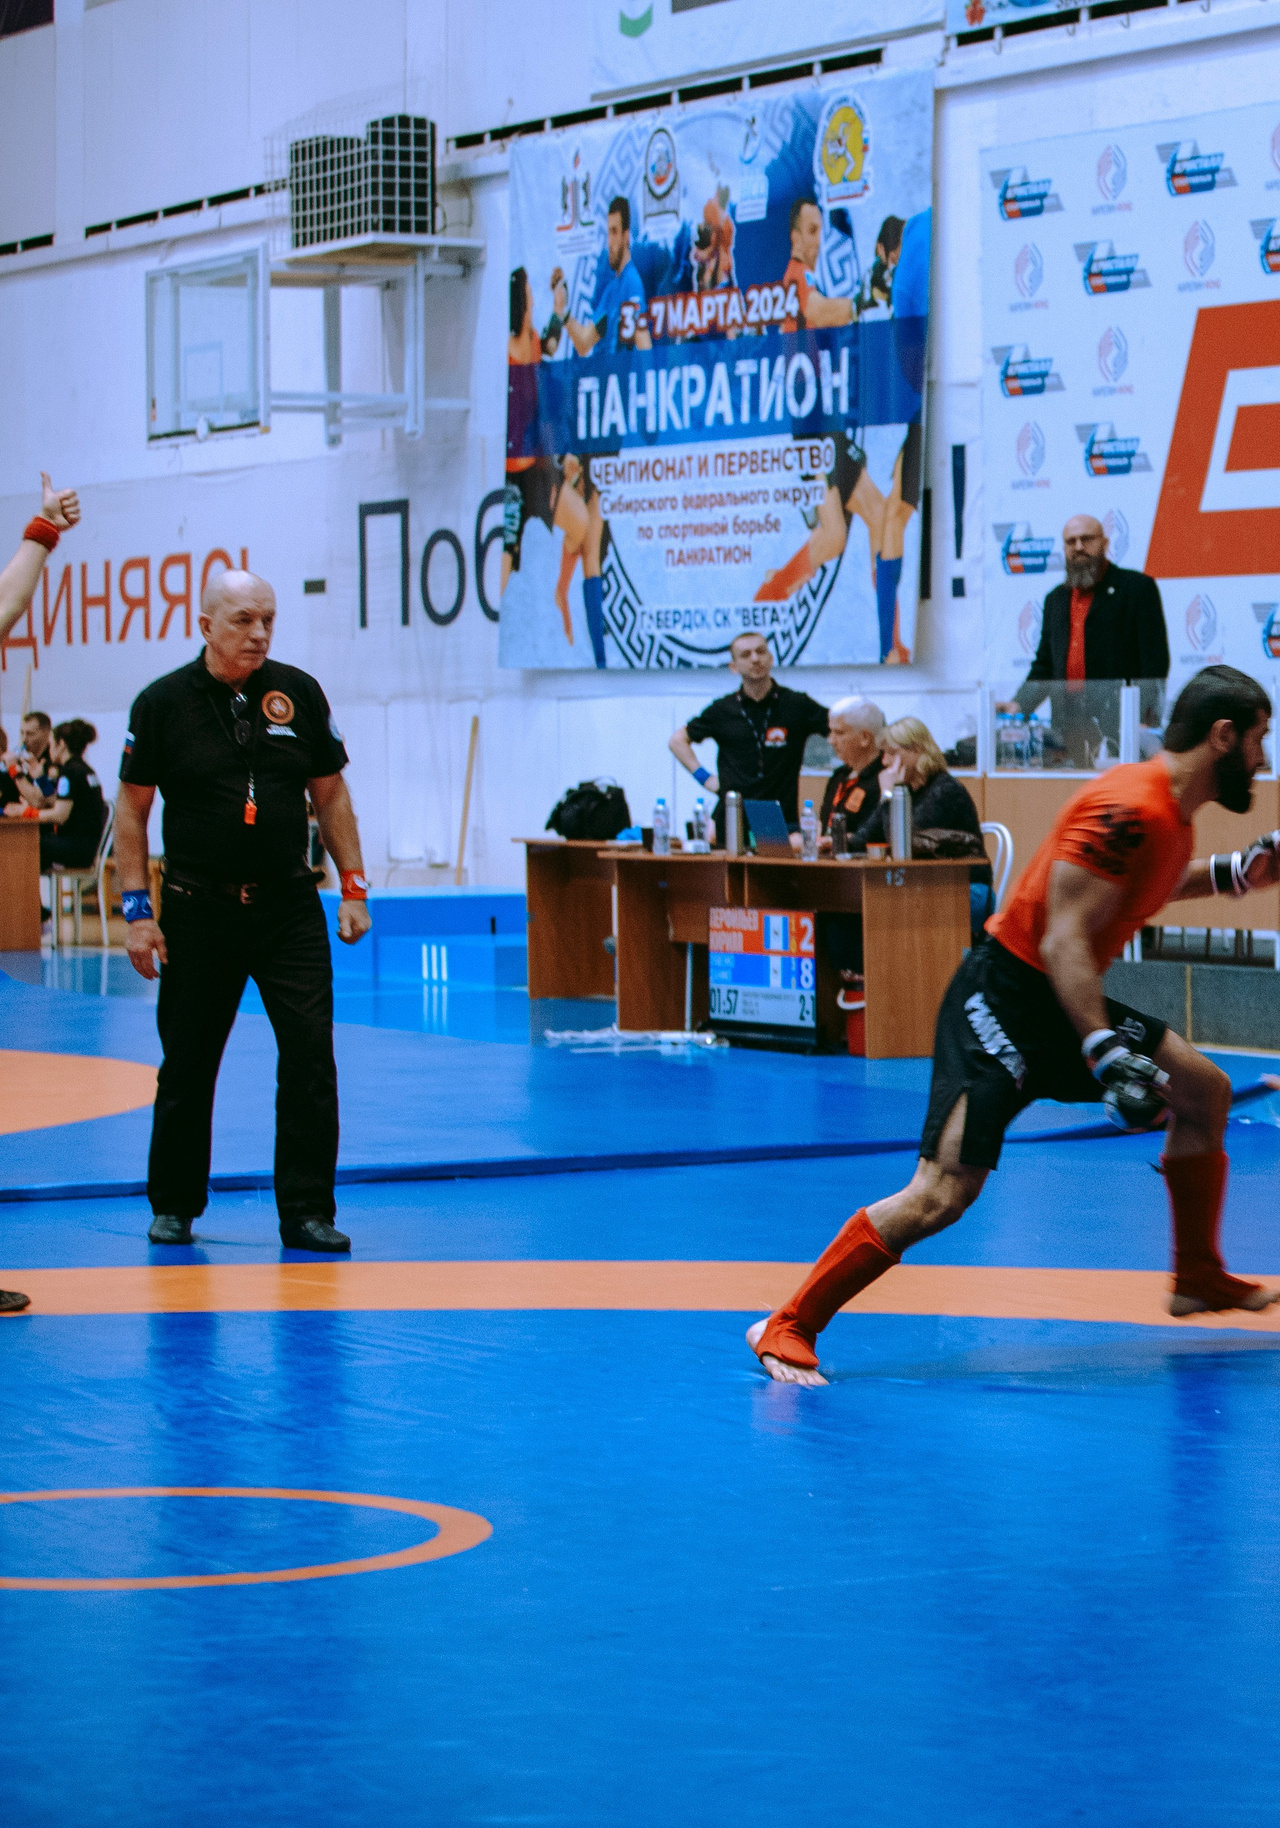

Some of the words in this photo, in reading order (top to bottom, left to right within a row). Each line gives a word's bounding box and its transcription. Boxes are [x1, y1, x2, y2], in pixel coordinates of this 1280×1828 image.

[621, 304, 636, 340] 3
[651, 301, 666, 336] 7
[667, 290, 743, 332] МАРТА
[746, 283, 800, 323] 2024
[577, 347, 849, 438] ПАНКРАТИОН
[593, 456, 693, 485] ЧЕМПИОНАТ
[699, 454, 710, 477] И
[714, 444, 833, 475] ПЕРВЕНСТВО
[602, 493, 678, 516] Сибирского
[666, 546, 752, 567] ПАНКРАТИОН
[800, 917, 814, 952] 2
[800, 957, 814, 989] 8
